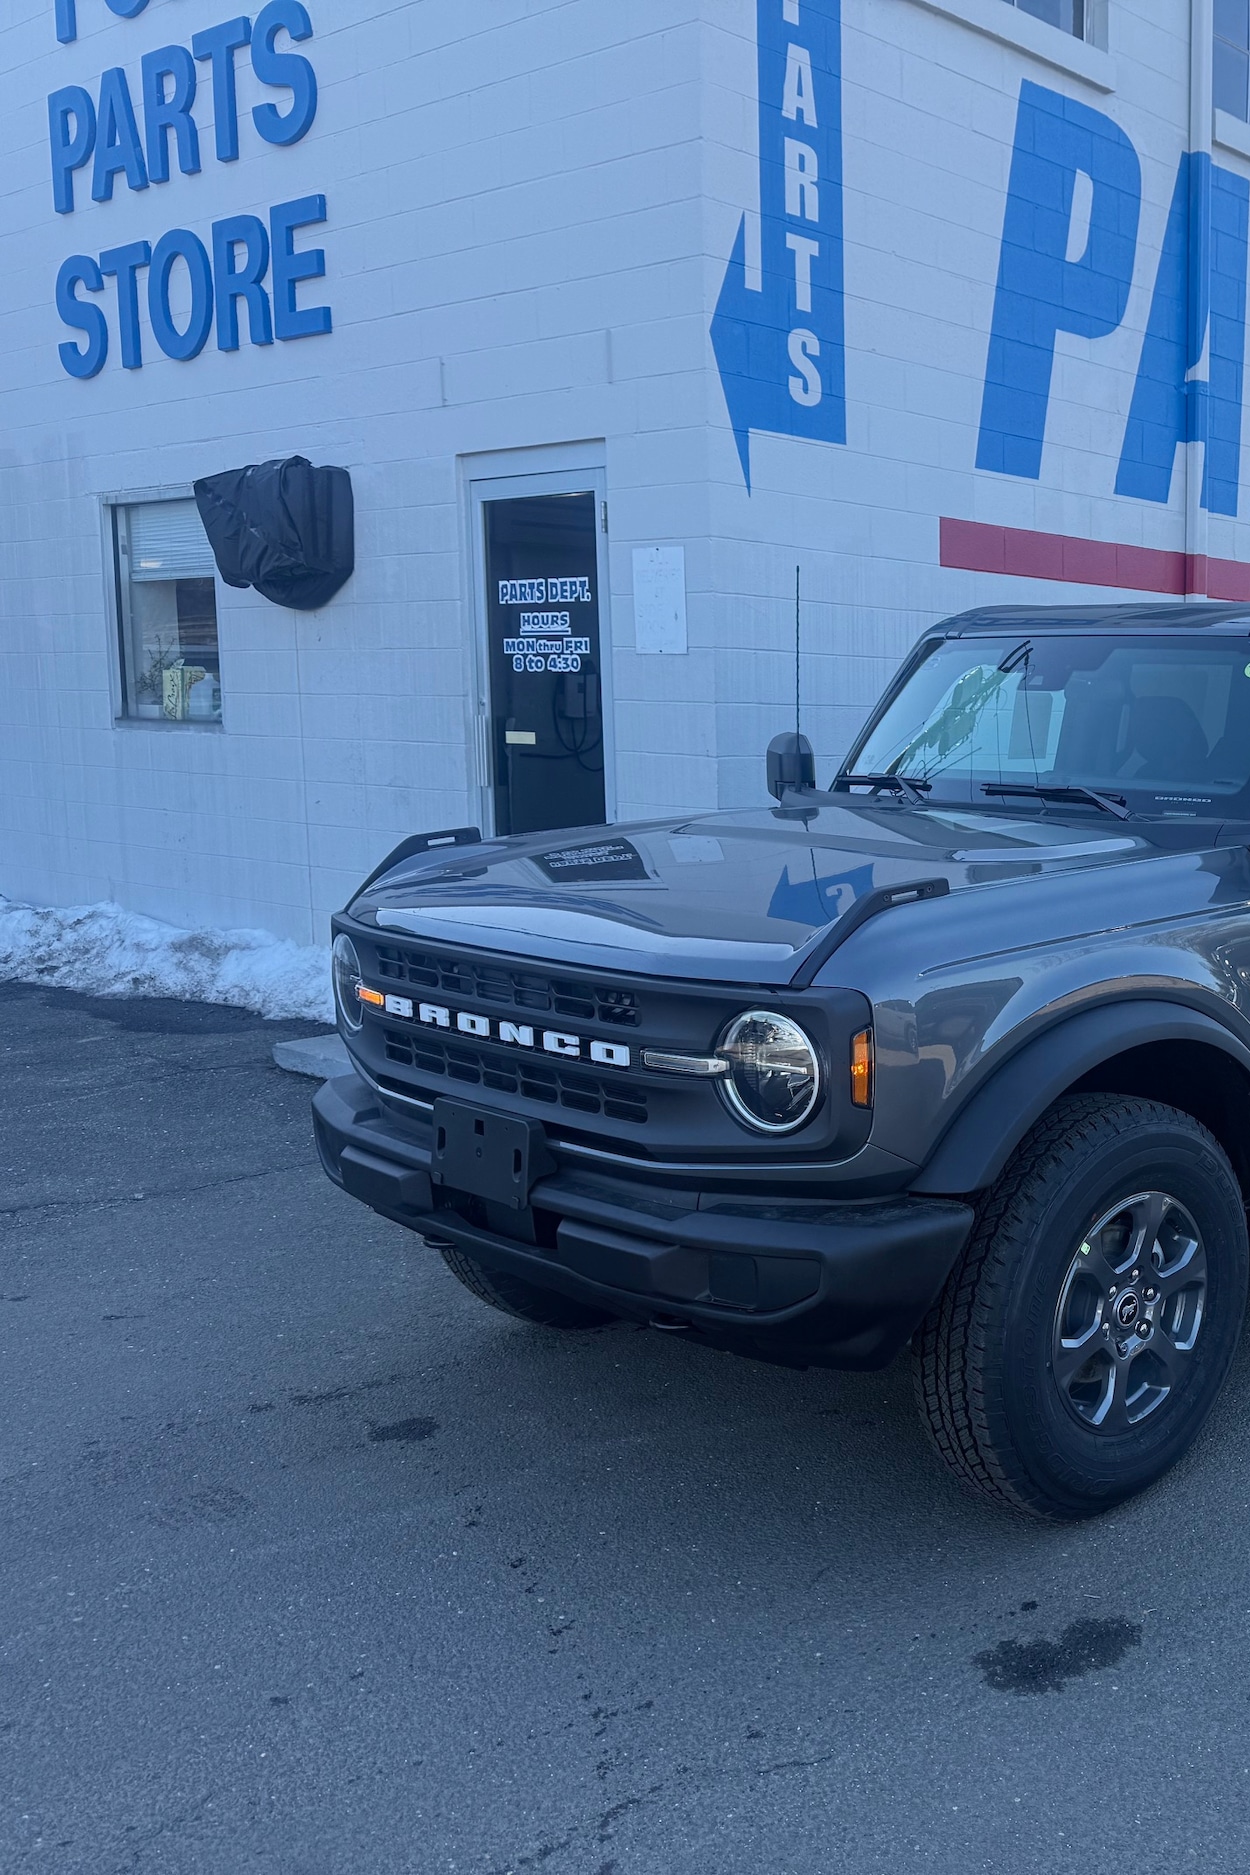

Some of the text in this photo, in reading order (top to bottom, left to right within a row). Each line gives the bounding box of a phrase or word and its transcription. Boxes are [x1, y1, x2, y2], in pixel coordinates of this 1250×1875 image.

[48, 0, 318, 214] PARTS
[55, 194, 332, 380] STORE
[499, 577, 591, 604] PARTS DEPT.
[520, 611, 570, 629] HOURS
[504, 637, 590, 654] MON thru FRI
[513, 654, 581, 672] 8 to 4:30
[385, 994, 631, 1067] BRONCO
